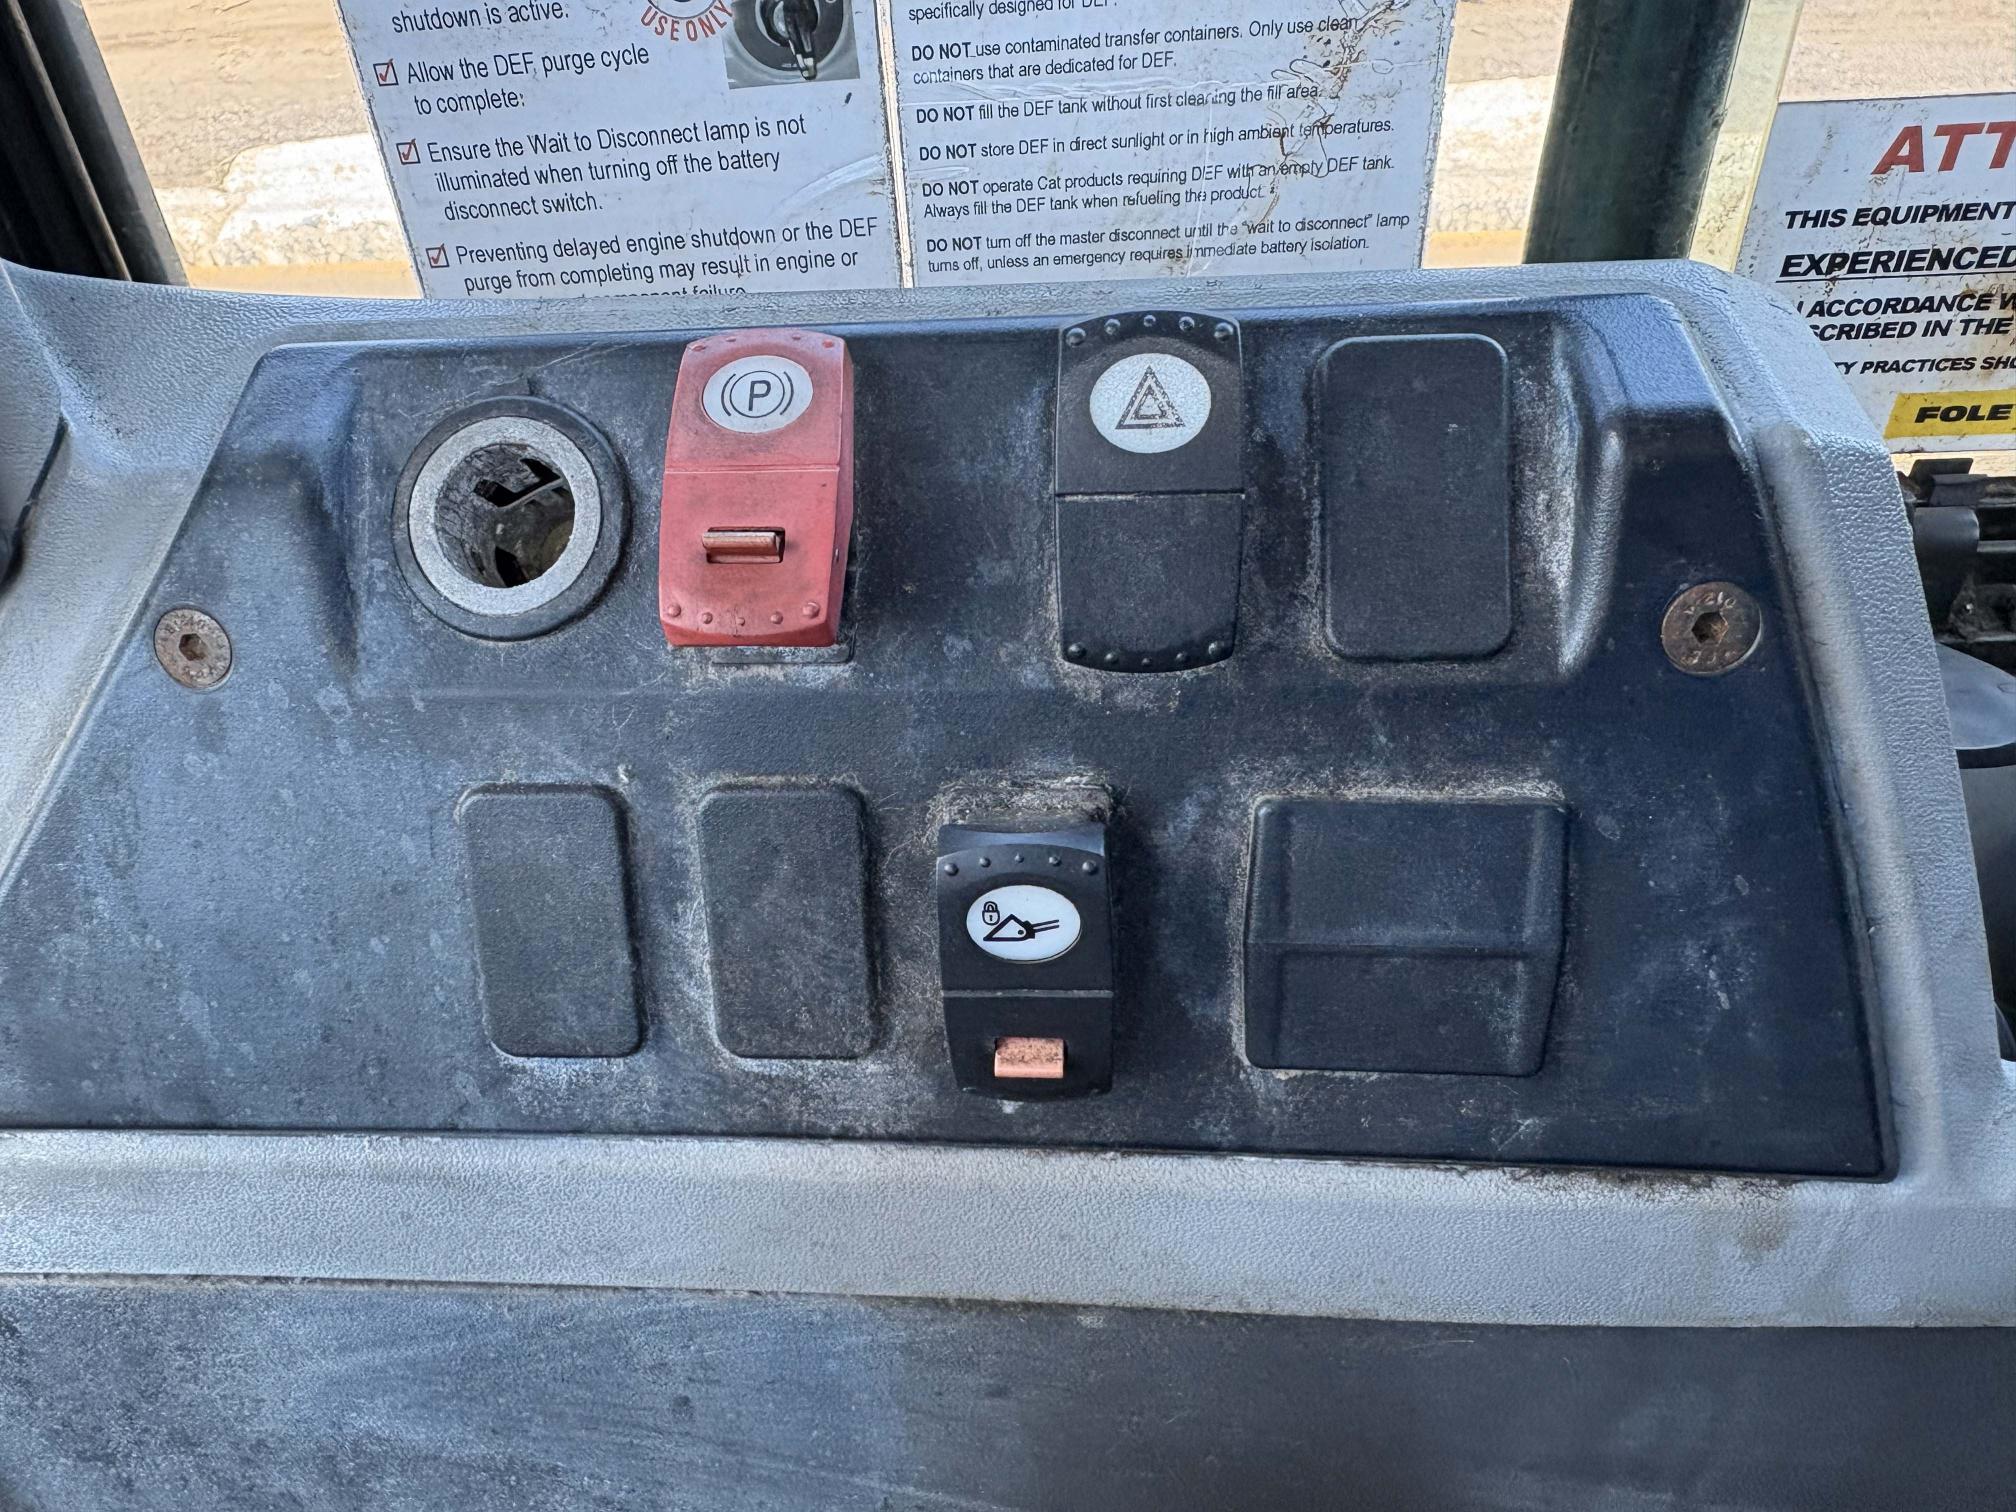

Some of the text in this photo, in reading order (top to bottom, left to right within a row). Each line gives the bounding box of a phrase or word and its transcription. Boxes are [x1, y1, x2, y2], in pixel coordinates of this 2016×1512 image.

[392, 0, 569, 33] shutdown is active.
[641, 0, 732, 41] USE ONLY
[909, 0, 984, 24] specifically
[989, 0, 1053, 16] designed
[912, 16, 1358, 61] DO NOT use contaminated transfer containers. Only use clean
[407, 62, 454, 84] Allow
[459, 58, 488, 79] the
[542, 51, 595, 78] purge
[600, 43, 649, 71] cycle
[913, 51, 1177, 84] containers that are dedicated for DEF.
[414, 96, 432, 115] to
[917, 108, 938, 123] DO
[943, 105, 975, 122] NOT
[979, 104, 993, 119] fill
[998, 103, 1019, 117] the
[1024, 100, 1054, 116] DEF
[1058, 99, 1087, 114] tank
[1092, 94, 1141, 112] without
[1146, 93, 1172, 108] first
[1241, 87, 1262, 102] the
[1267, 85, 1282, 100] fill
[427, 114, 807, 163] Ensure the Wait to Disconnect lamp is not
[920, 146, 941, 161] DO
[946, 144, 977, 160] NOT
[981, 142, 1015, 157] store
[1019, 139, 1049, 155] DEF
[1053, 138, 1065, 153] in
[1070, 135, 1107, 152] direct
[1111, 132, 1165, 150] sunlight
[1169, 132, 1183, 145] or
[1187, 128, 1198, 144] in
[1203, 128, 1234, 146] high
[1238, 124, 1294, 141] ambient
[1871, 121, 2016, 175] ATT
[434, 150, 780, 193] illuminated when turning off the battery
[922, 182, 943, 197] DO
[948, 180, 979, 195] NOT
[983, 177, 1034, 195] operate
[1037, 176, 1061, 191] Cat
[1065, 172, 1123, 192] products
[1127, 166, 1187, 188] requiring
[1327, 156, 1359, 174] DEF
[1362, 155, 1395, 171] tank.
[444, 191, 603, 221] disconnect switch.
[924, 203, 970, 220] Always
[974, 201, 987, 216] fill
[991, 200, 1011, 215] the
[1016, 197, 1045, 213] DEF
[1050, 195, 1078, 211] tank
[1081, 194, 1118, 209] when
[1123, 189, 1180, 206] refueling
[1185, 186, 1206, 202] the
[1785, 201, 2016, 229] THIS EQUIPMENT
[456, 217, 878, 265] Preventing delayed engine shutdown or the DEF
[926, 238, 947, 252] DO
[952, 235, 982, 251] NOT
[986, 235, 1011, 249] turn
[1015, 233, 1032, 247] off
[1036, 231, 1056, 246] the
[1060, 229, 1105, 245] master
[1109, 222, 1180, 243] disconnect
[1184, 221, 1213, 238] until
[1217, 221, 1238, 236] the
[1278, 217, 1291, 232] to
[1376, 213, 1410, 230] lamp
[928, 236, 1369, 273] turns off, unless an emergency requires immediate battery isolation.
[1779, 245, 2016, 278] EXPERIENCED
[464, 251, 858, 296] purge from completing may result in engine or
[1806, 293, 1994, 318] ACCORDANCE
[1921, 319, 1953, 337] IN
[1959, 317, 2014, 336] THE
[1859, 357, 1976, 374] PRACTICES
[1980, 356, 2016, 371] SH
